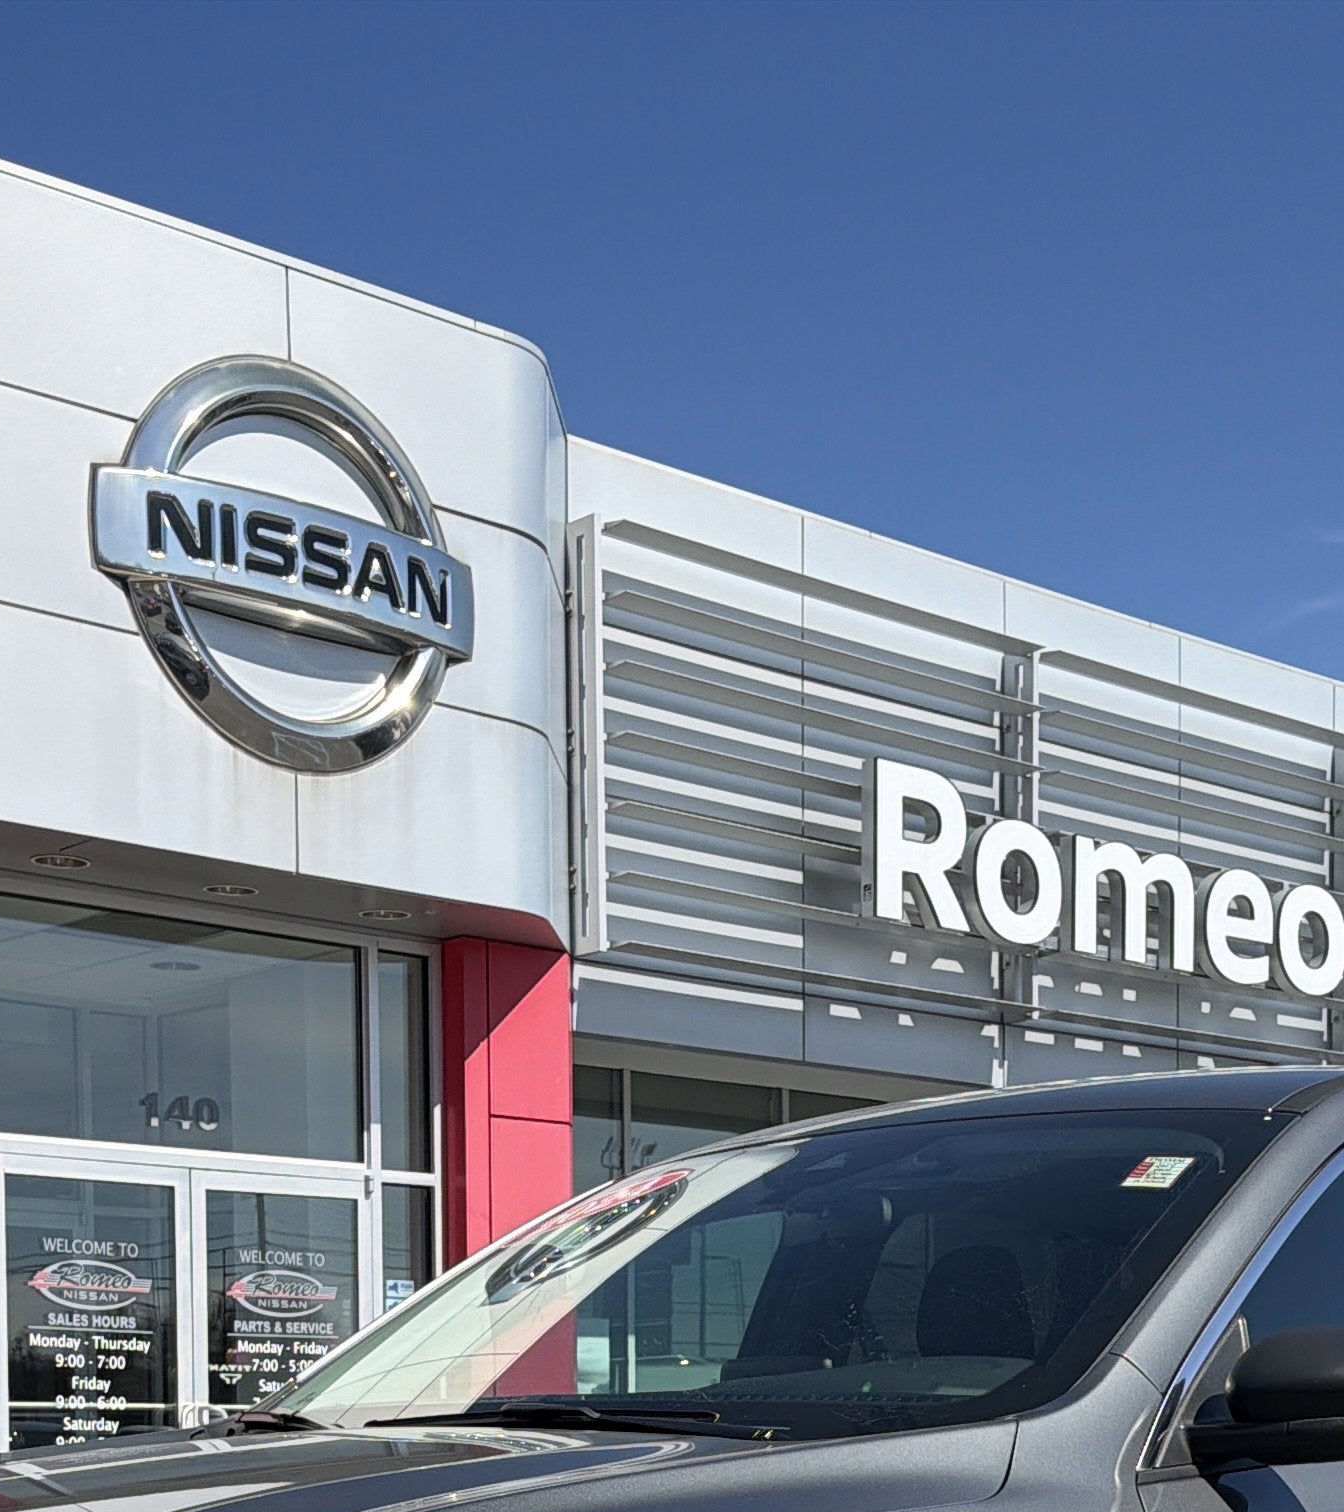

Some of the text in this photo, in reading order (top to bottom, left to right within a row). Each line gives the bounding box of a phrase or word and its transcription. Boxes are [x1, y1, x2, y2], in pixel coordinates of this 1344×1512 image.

[145, 489, 452, 630] NISSAN
[139, 1093, 220, 1131] 140
[43, 1236, 138, 1258] WELCOME TO
[239, 1249, 325, 1268] WELCOME TO
[56, 1262, 132, 1289] Romeo
[252, 1273, 320, 1297] Romeo
[63, 1289, 119, 1302] NISSAN
[258, 1299, 308, 1309] NISSAN
[48, 1312, 137, 1329] SALES HOURS
[233, 1320, 334, 1335] PARTS & SERVICE
[29, 1333, 81, 1351] Monday
[91, 1336, 151, 1354] Thursday
[237, 1340, 284, 1356] Monday
[293, 1341, 328, 1356] Friday
[55, 1354, 86, 1368] 9:00
[97, 1355, 126, 1370] 7:00
[252, 1358, 278, 1372] 7:00
[71, 1376, 111, 1393] Friday
[56, 1395, 86, 1410] 9:00
[97, 1396, 126, 1410] 6:00
[62, 1416, 120, 1434] Saturday
